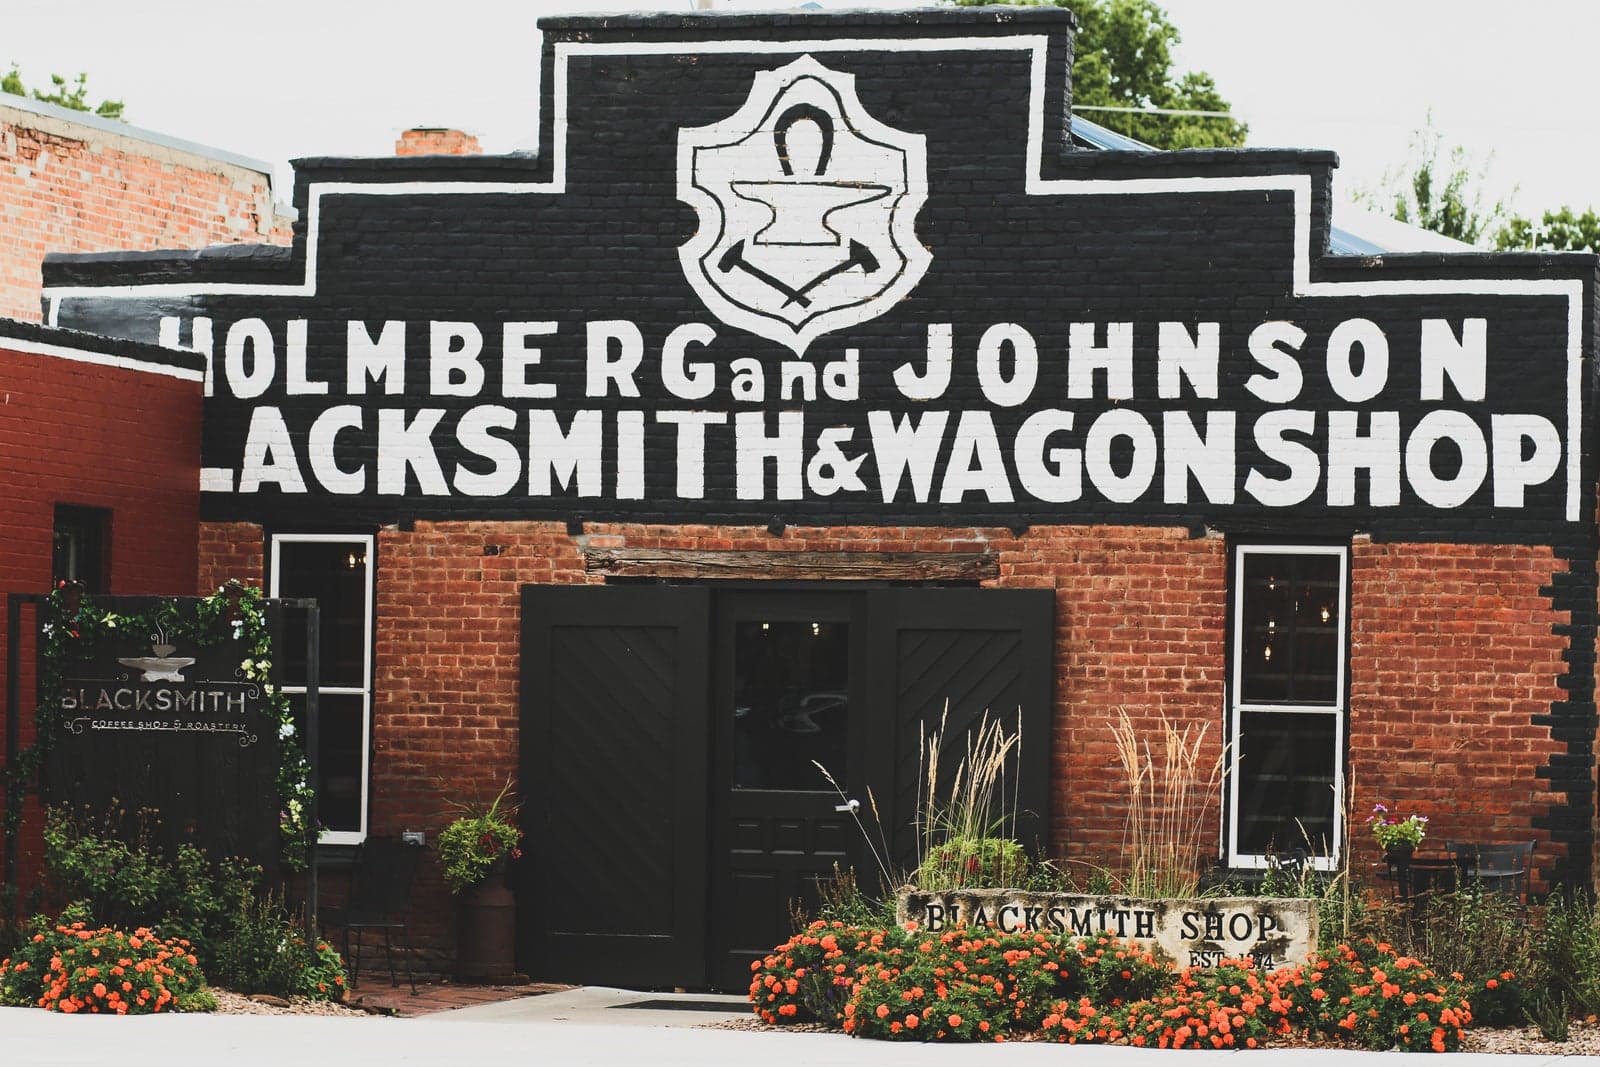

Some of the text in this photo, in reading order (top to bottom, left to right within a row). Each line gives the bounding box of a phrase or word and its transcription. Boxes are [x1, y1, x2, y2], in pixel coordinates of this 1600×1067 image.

[730, 348, 859, 402] and
[893, 317, 1487, 406] JOHNSON
[62, 688, 245, 713] BLACKSMITH
[91, 720, 134, 730] COFFEE
[138, 720, 169, 730] SHOP
[187, 721, 246, 732] ROASTERY
[1180, 910, 1277, 942] SHOP
